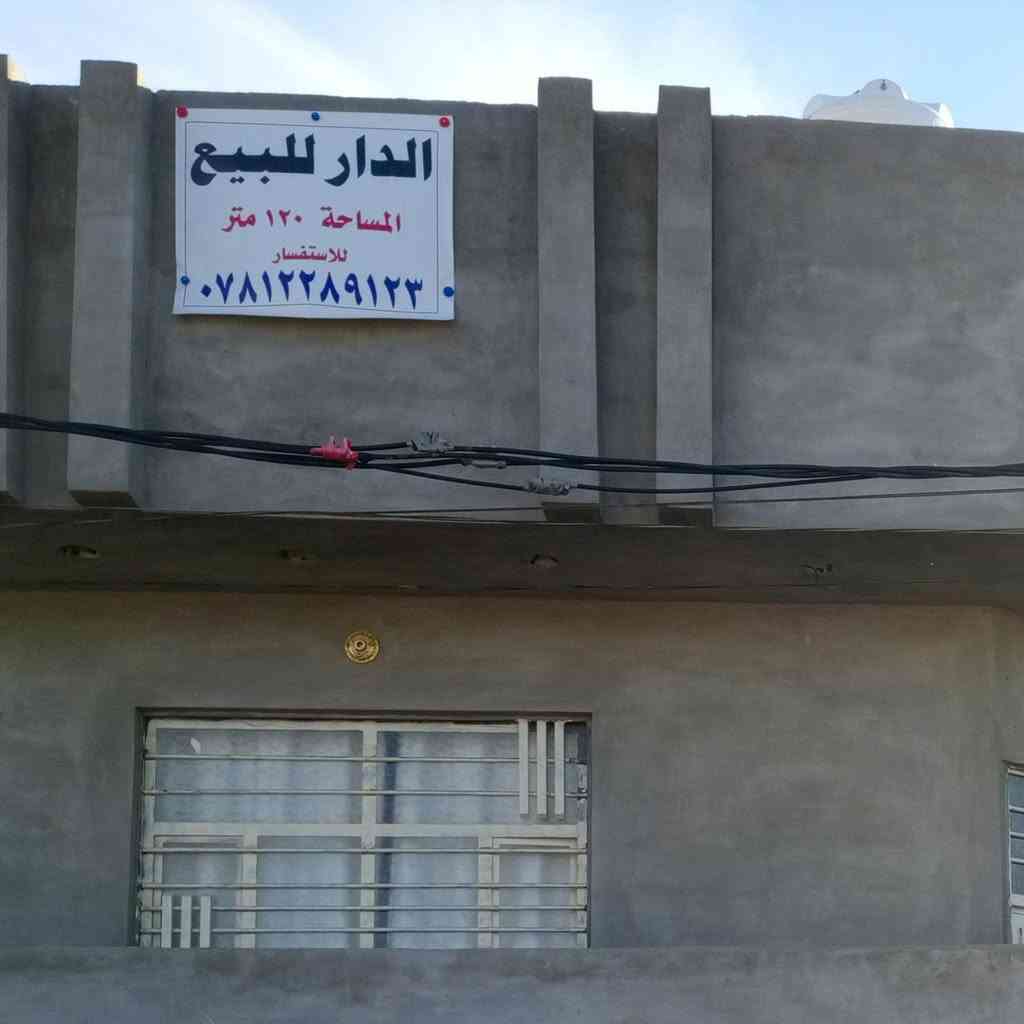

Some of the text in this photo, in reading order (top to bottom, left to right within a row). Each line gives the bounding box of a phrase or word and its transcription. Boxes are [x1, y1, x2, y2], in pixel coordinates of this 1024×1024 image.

[190, 132, 432, 186] الدار للبيع
[221, 205, 401, 233] المساحة ١٢٠ متر
[271, 244, 348, 264] للاستفسار
[200, 269, 423, 310] ٠٧٨١٢٢٨٩١٢٣
